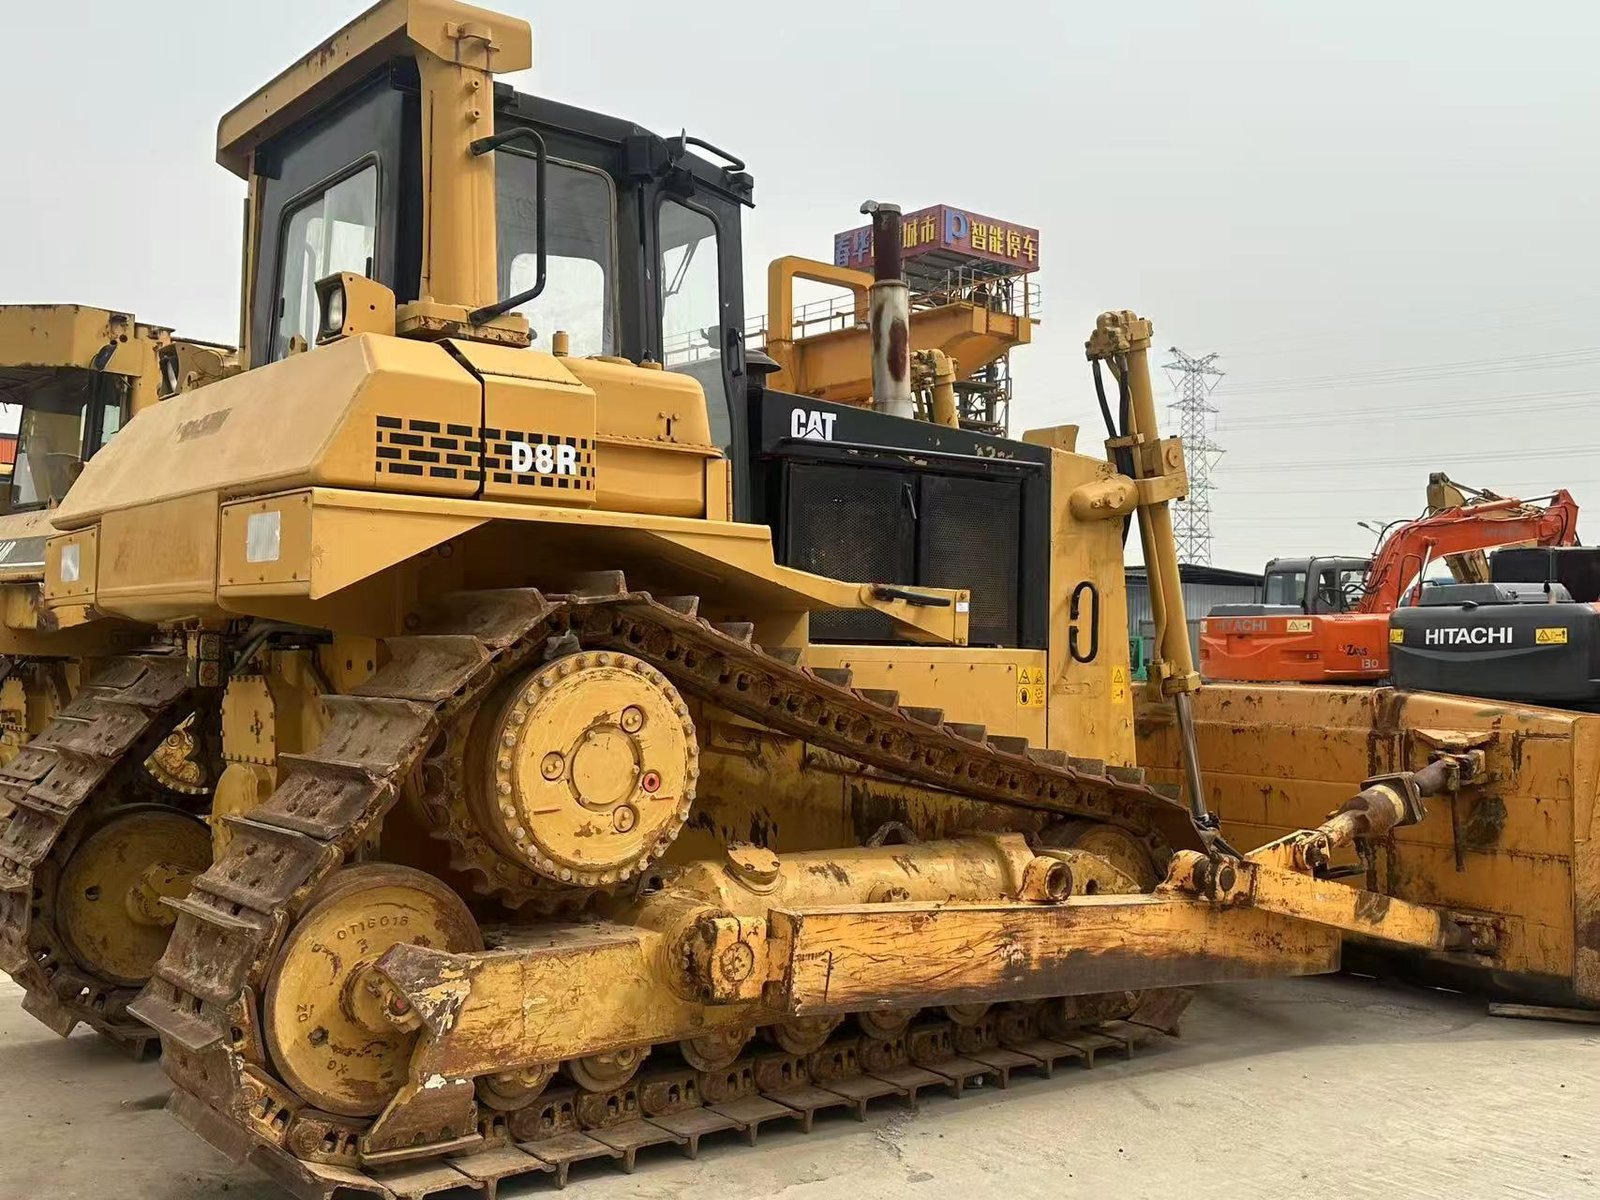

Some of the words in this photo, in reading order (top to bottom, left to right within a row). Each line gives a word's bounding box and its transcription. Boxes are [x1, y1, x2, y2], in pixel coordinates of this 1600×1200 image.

[971, 220, 1038, 262] 智能停车
[791, 408, 837, 441] CAT
[511, 441, 577, 475] D8R
[1425, 627, 1513, 645] HITACHI
[1361, 658, 1379, 669] 130
